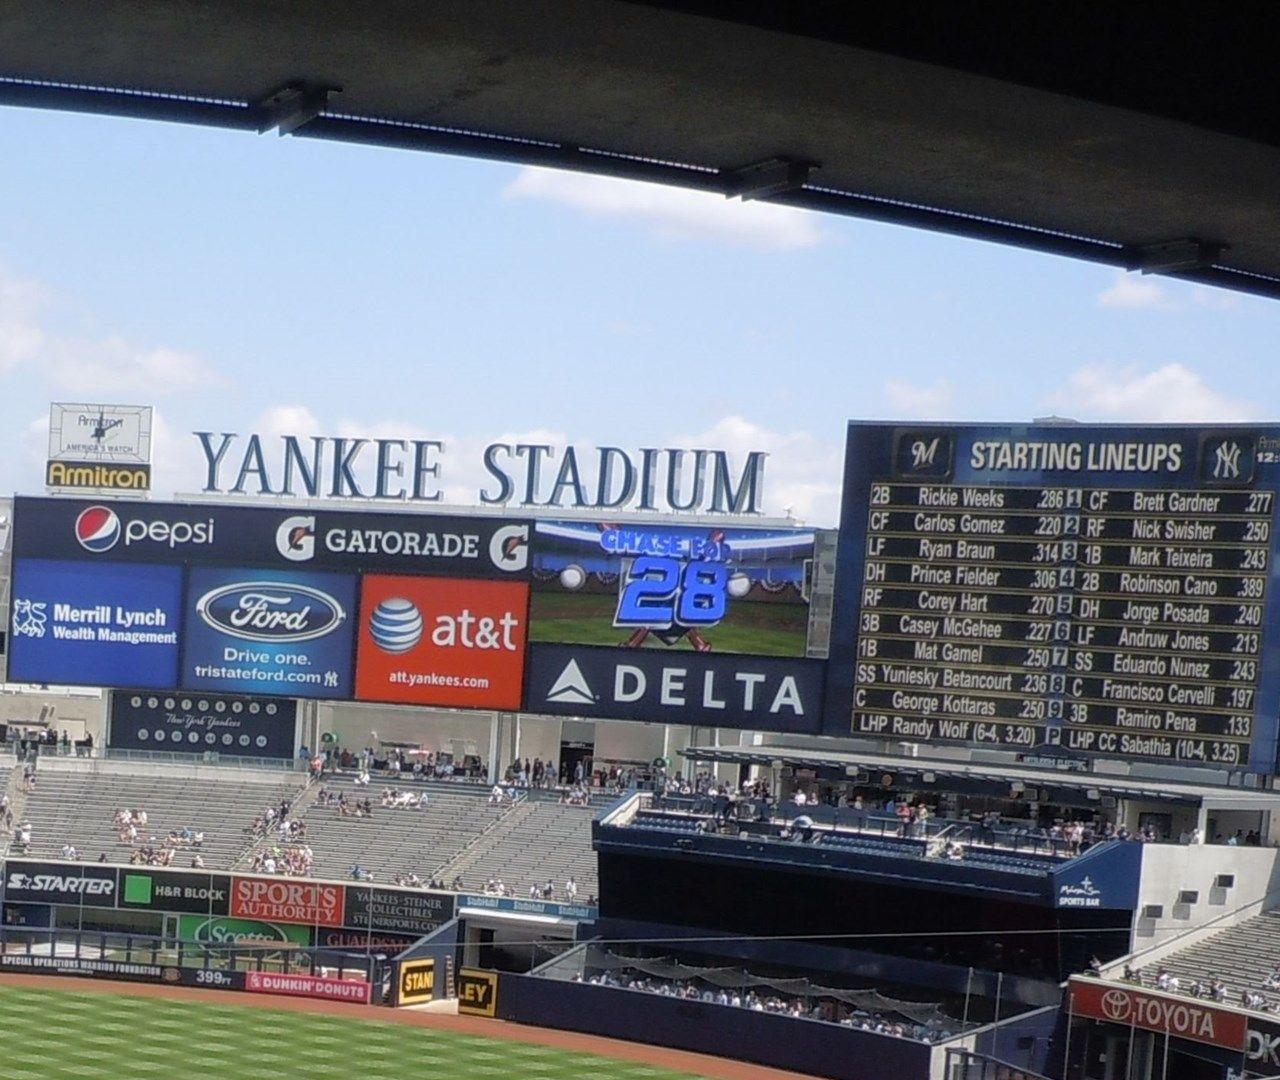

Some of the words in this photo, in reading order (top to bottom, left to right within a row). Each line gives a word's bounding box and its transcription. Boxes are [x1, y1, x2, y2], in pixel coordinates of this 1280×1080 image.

[970, 441, 1082, 471] STARTING
[1087, 443, 1182, 472] LINEUPS
[49, 463, 147, 488] Armitron
[192, 431, 444, 499] YANKEE
[480, 444, 770, 515] STADIUM
[872, 487, 890, 504] 2B
[919, 488, 958, 506] Rickie
[963, 489, 1004, 508] Weeks
[1037, 490, 1063, 508] .286
[1090, 492, 1108, 510] CF
[1133, 492, 1165, 511] Brett
[1169, 493, 1220, 512] Gardner
[1245, 493, 1271, 513] .277
[125, 518, 214, 546] pepsi
[870, 513, 889, 530] CF
[914, 513, 955, 532] Carlos
[960, 514, 1005, 534] Gomez
[1034, 516, 1060, 535] .220
[1086, 519, 1106, 537] RF
[1132, 520, 1160, 539] Nick
[1165, 521, 1216, 540] Swisher
[1242, 522, 1269, 541] .250
[325, 529, 479, 558] GATORADE
[600, 530, 685, 555] CHASE
[868, 539, 886, 556] LF
[919, 539, 952, 562] Ryan
[956, 540, 995, 559] Braun
[1032, 544, 1058, 562] .314
[1085, 546, 1102, 565] 1B
[1129, 547, 1160, 567] Mark
[1166, 548, 1213, 568] Teixeira
[1239, 550, 1266, 569] .243
[866, 563, 886, 581] DH
[911, 565, 951, 584] Prince
[956, 567, 1000, 586] Fielder
[1030, 571, 1056, 589] .306
[1082, 572, 1100, 591] 2B
[1120, 573, 1181, 594] Robinson
[1184, 576, 1218, 595] Cano
[1237, 579, 1263, 597] .389
[612, 556, 730, 629] 28
[864, 589, 883, 606] RF
[918, 591, 957, 614] Corey
[961, 593, 988, 612] Hart
[1027, 597, 1054, 615] .270
[54, 604, 111, 624] Merrill
[116, 607, 166, 628] Lynch
[230, 593, 308, 631] Ford
[1080, 599, 1100, 618] DH
[1123, 601, 1160, 625] Jorge
[1163, 602, 1210, 623] Posada
[53, 628, 96, 641] Wealth
[98, 629, 177, 645] Management
[432, 609, 519, 650] at&t
[862, 614, 880, 631] 3B
[899, 615, 939, 638] Casey
[943, 618, 1002, 638] McGehee
[1025, 623, 1051, 641] .227
[1078, 626, 1095, 645] LF
[1171, 630, 1210, 651] Jones
[224, 648, 270, 665] Drive
[275, 652, 312, 666] one.
[860, 639, 877, 657] 1B
[914, 642, 938, 660] Mat
[942, 644, 983, 663] Gamel
[1023, 649, 1050, 668] .250
[1075, 652, 1093, 671] SS
[1113, 653, 1166, 675] Eduardo
[1170, 656, 1210, 678] Nunez
[1229, 661, 1256, 680] .243
[195, 666, 321, 683] tristateford.com
[389, 672, 489, 689] att.yankees.com
[857, 665, 876, 683] SS
[882, 666, 939, 689] Yuniesky
[943, 669, 1012, 691] Betancourt
[1020, 675, 1047, 693] .236
[614, 664, 804, 716] DELTA
[1072, 678, 1083, 697] C
[1102, 680, 1164, 702] Francisco
[1168, 683, 1215, 706] Cervelli
[1227, 689, 1253, 708] .197
[856, 690, 866, 707] C
[892, 692, 939, 715] George
[943, 695, 996, 716] Kottaras
[1018, 701, 1045, 719] .250
[860, 715, 888, 733] LHP
[892, 717, 934, 740] Randy
[939, 721, 969, 739] Wolf
[973, 723, 1000, 744] (6-4,
[1006, 726, 1036, 748] 3.20)
[1070, 703, 1088, 722] 3B
[1116, 708, 1161, 729] Ramiro
[1165, 711, 1196, 732] Pena
[1224, 717, 1250, 736] .133
[1069, 730, 1095, 749] LHP
[1099, 733, 1116, 751] CC
[1121, 735, 1172, 757] Sabathia
[1212, 743, 1240, 765] 3.25)
[155, 886, 181, 897] H&R
[184, 888, 224, 900] BLOCK
[237, 880, 336, 909] SPORTS
[238, 903, 335, 922] AUTHORITY
[2, 955, 32, 966] SPECIAL
[263, 976, 315, 992] DUNKIN'
[317, 981, 364, 998] DONUTS
[1135, 998, 1215, 1038] TOYOTA
